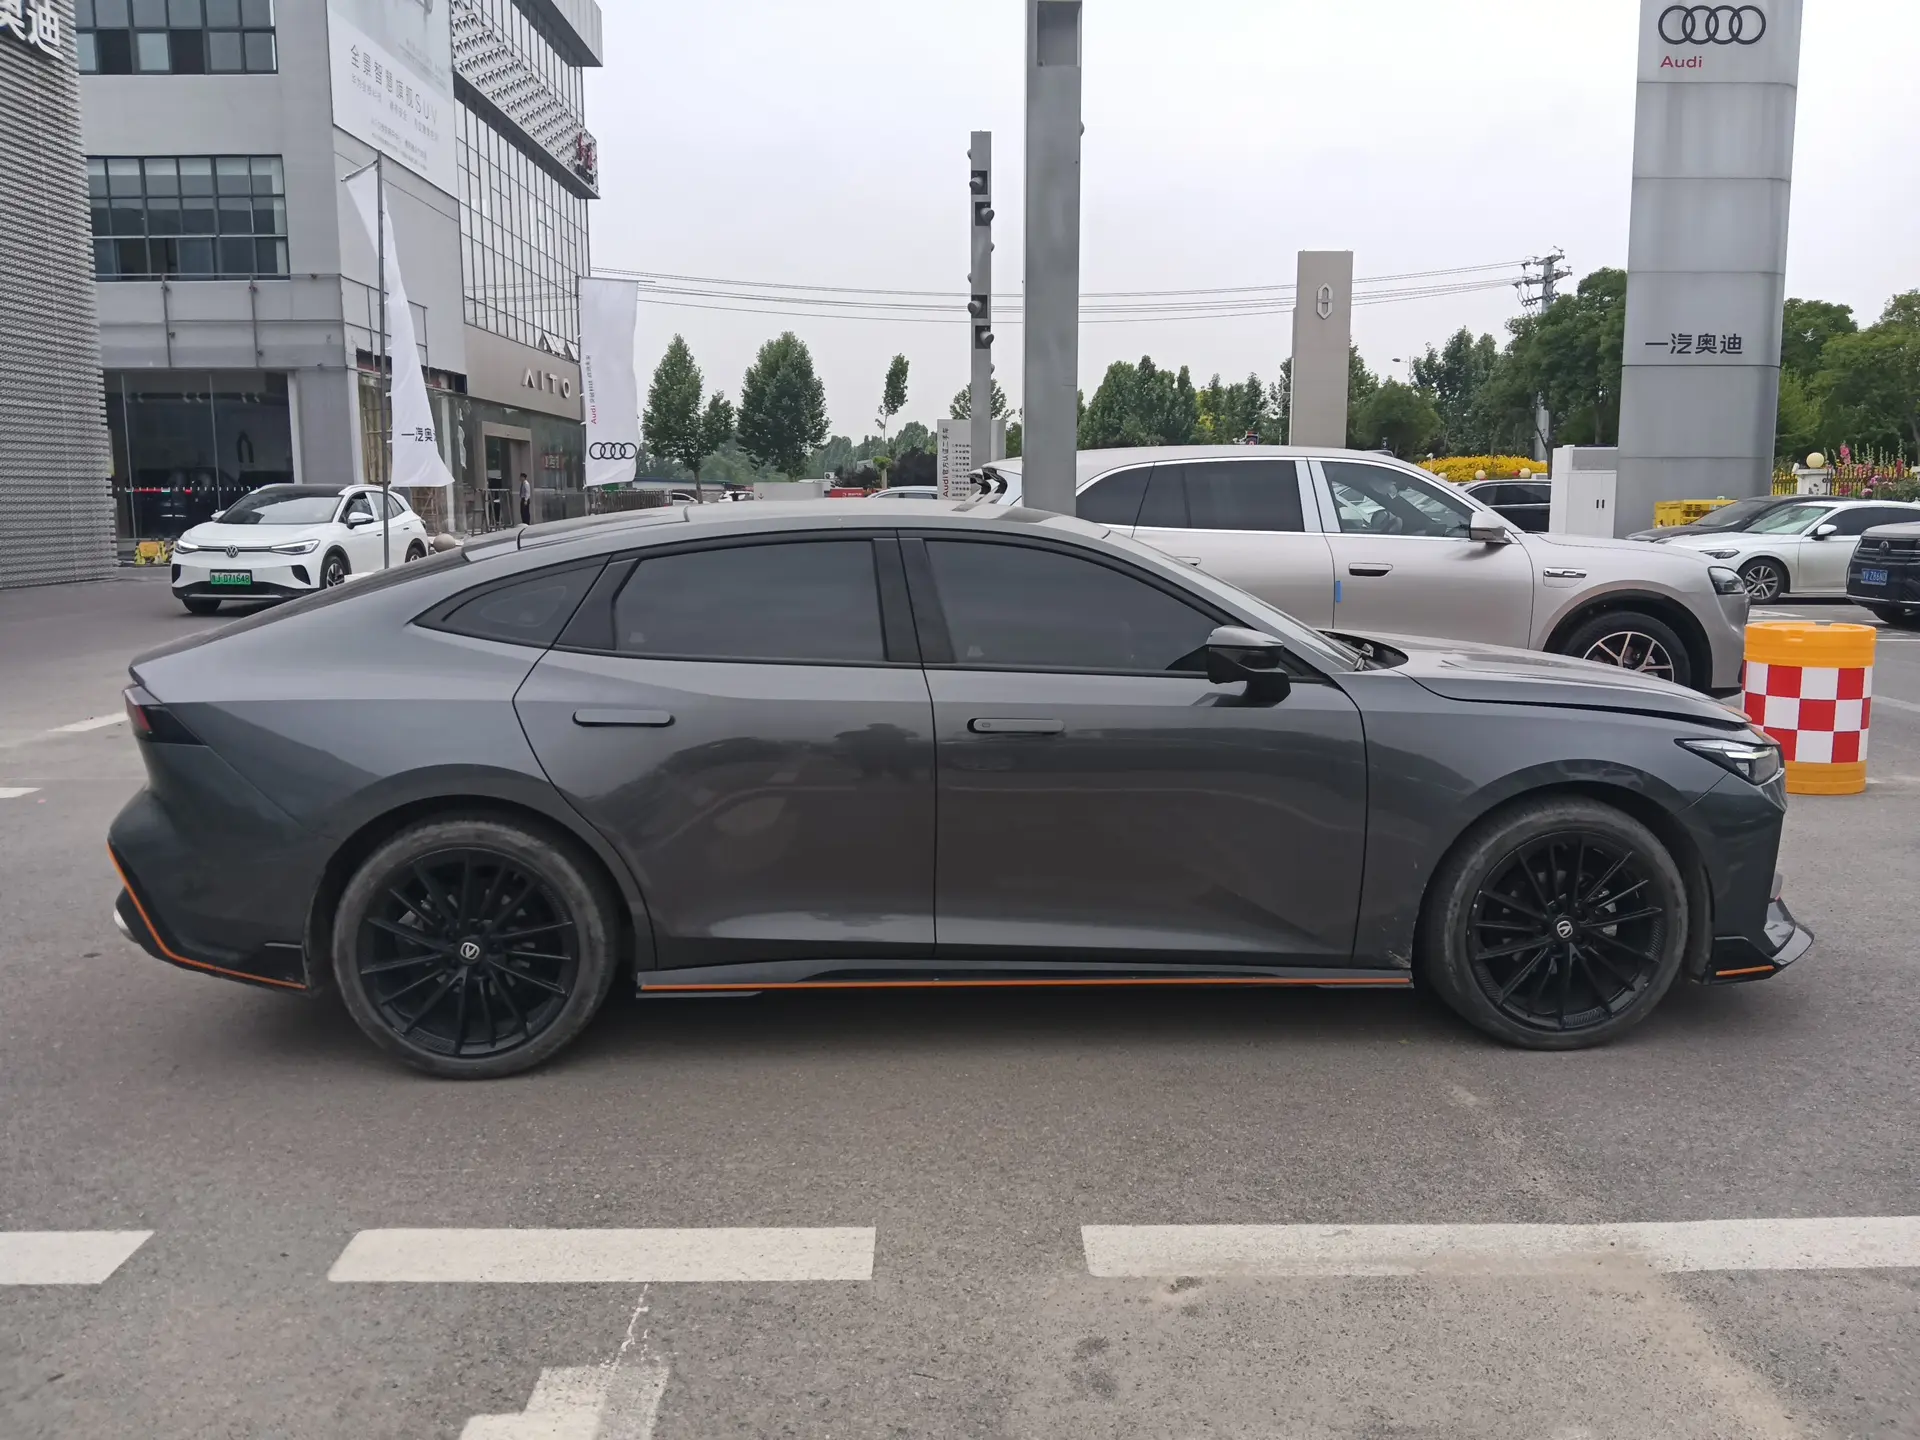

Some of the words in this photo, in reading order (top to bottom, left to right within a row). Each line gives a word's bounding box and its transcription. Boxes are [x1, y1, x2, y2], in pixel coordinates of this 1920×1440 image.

[1660, 56, 1703, 68] Audi
[1644, 333, 1743, 354] 一汽奥迪
[522, 368, 571, 399] AITO
[401, 427, 436, 442] 一汽奥
